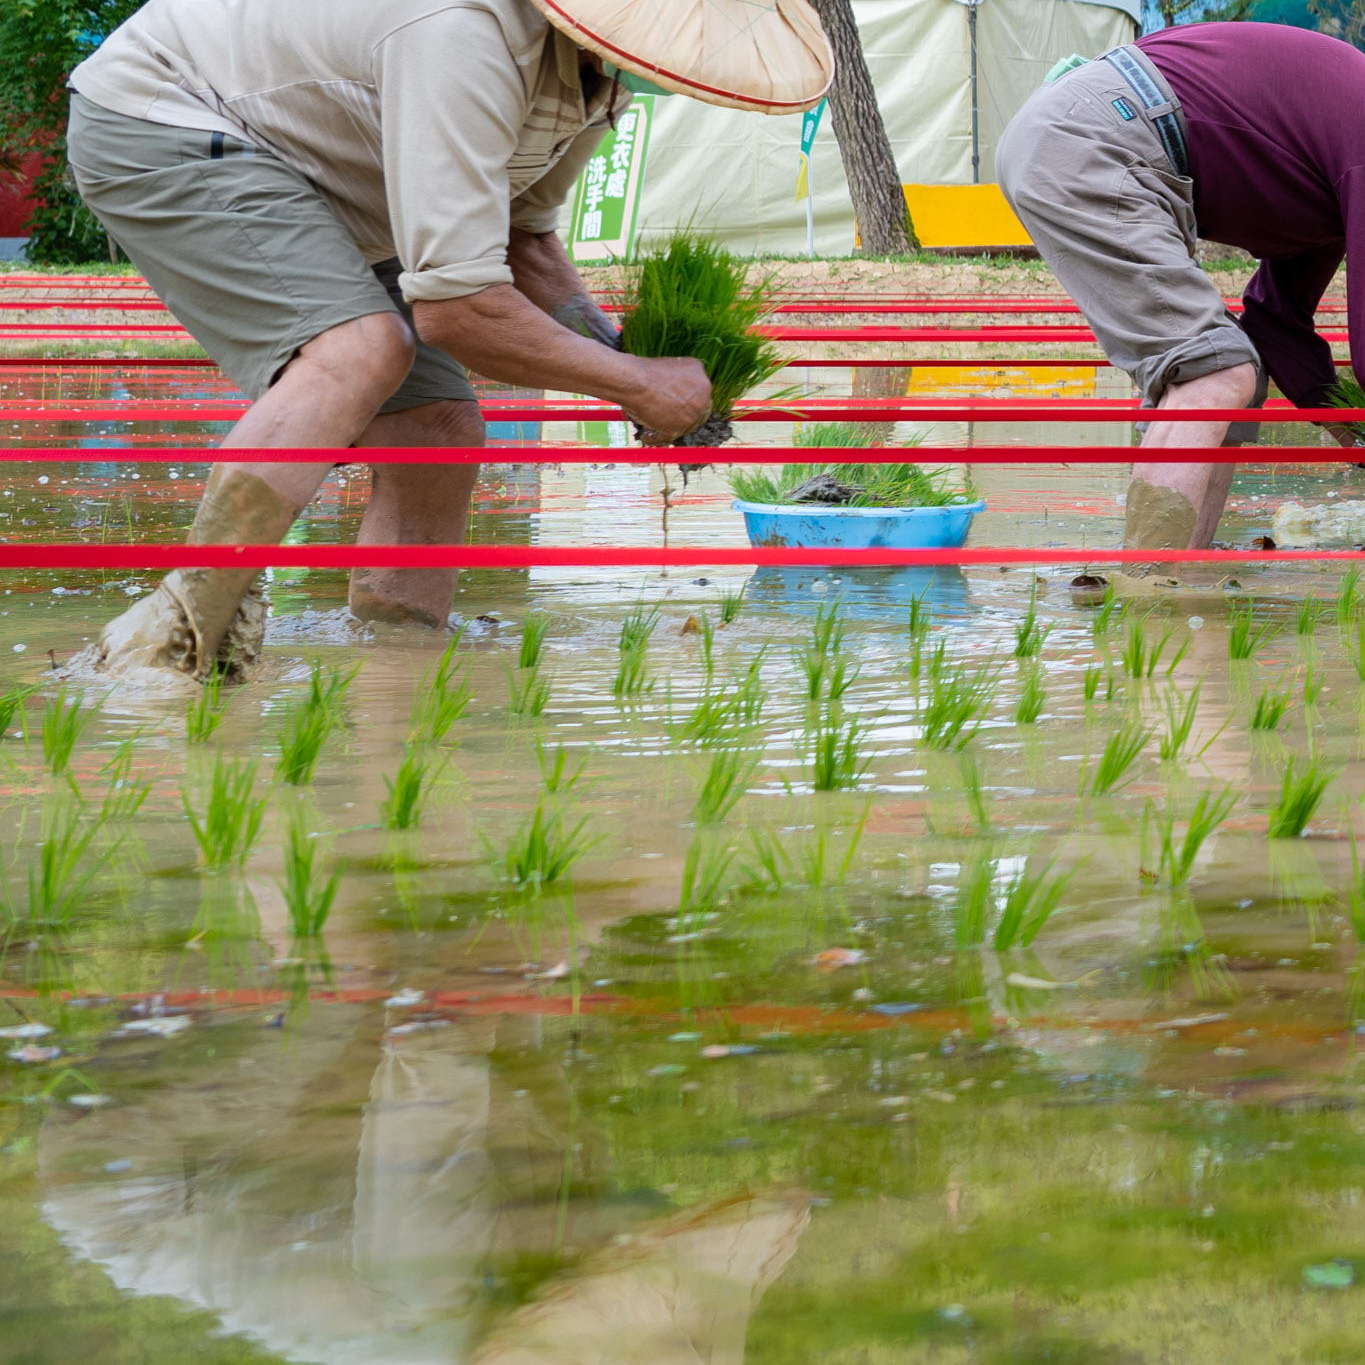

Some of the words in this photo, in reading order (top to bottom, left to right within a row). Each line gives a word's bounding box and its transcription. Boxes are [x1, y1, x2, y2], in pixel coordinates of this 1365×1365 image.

[581, 154, 608, 242] 洗手間
[605, 112, 638, 199] 更衣處
